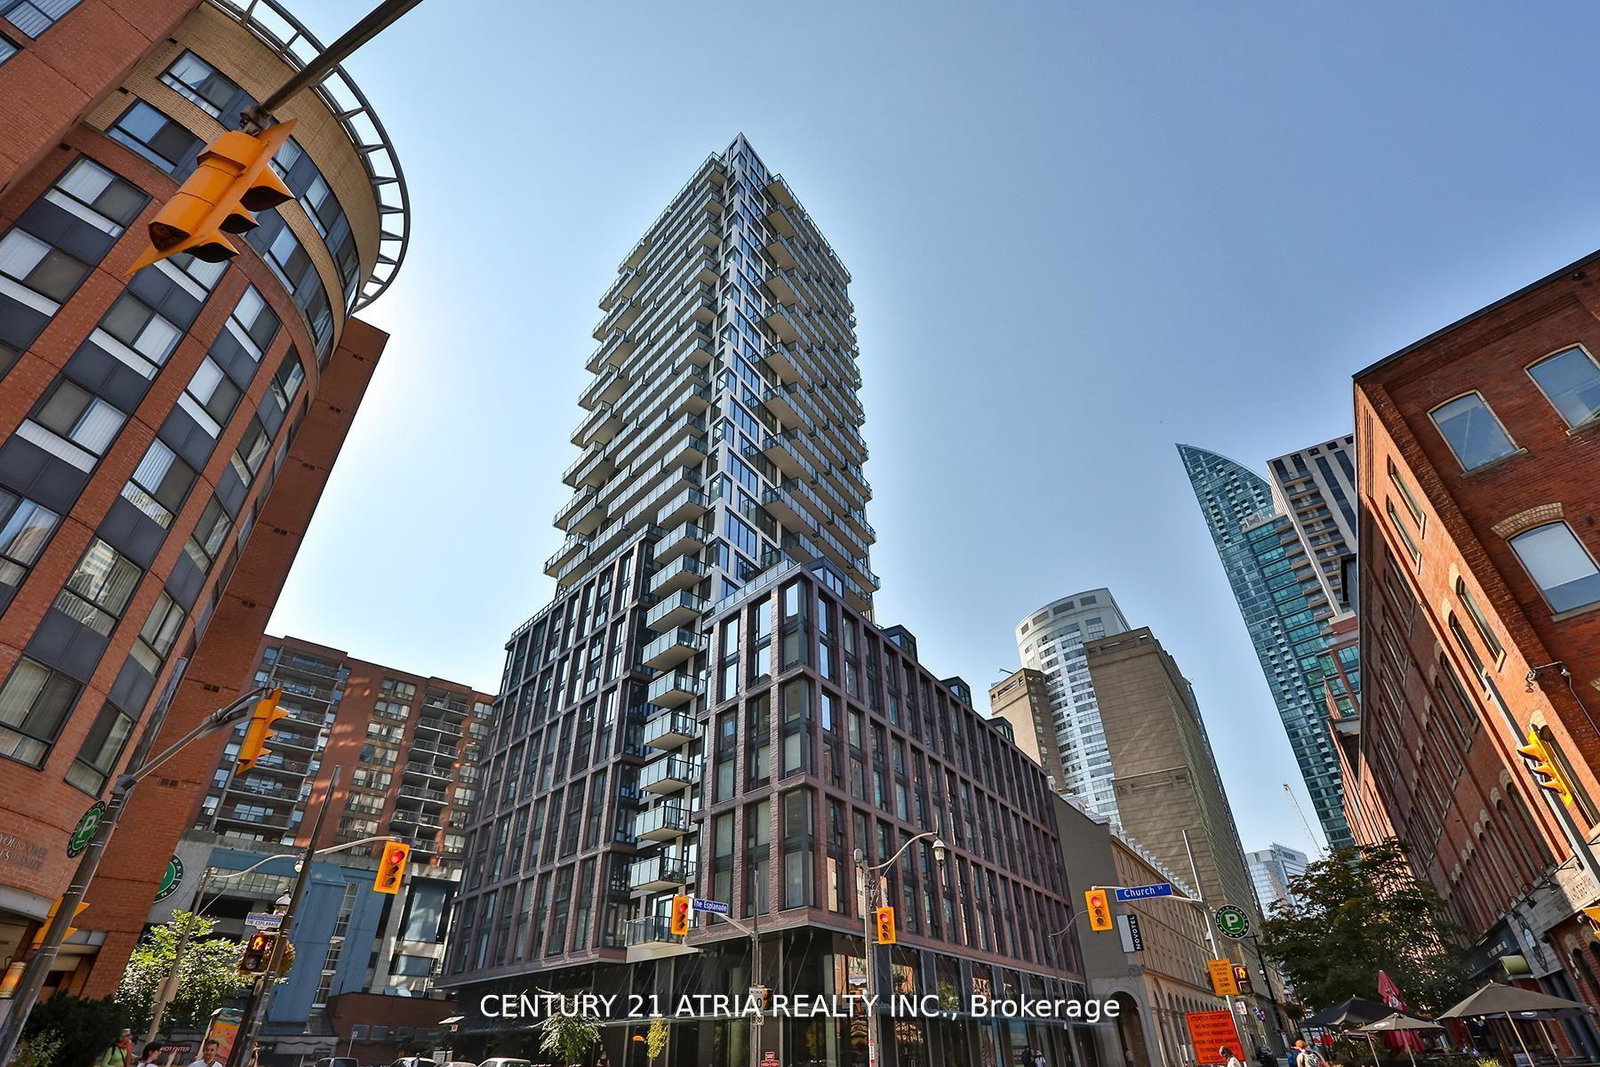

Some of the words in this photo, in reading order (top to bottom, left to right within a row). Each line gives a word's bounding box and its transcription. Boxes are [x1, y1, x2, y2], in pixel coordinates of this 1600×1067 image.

[79, 814, 97, 838] P
[1123, 886, 1156, 898] Church
[693, 899, 703, 908] The
[703, 901, 728, 912] Esplanade
[1224, 913, 1239, 928] P
[1130, 915, 1141, 950] NOVOTEL
